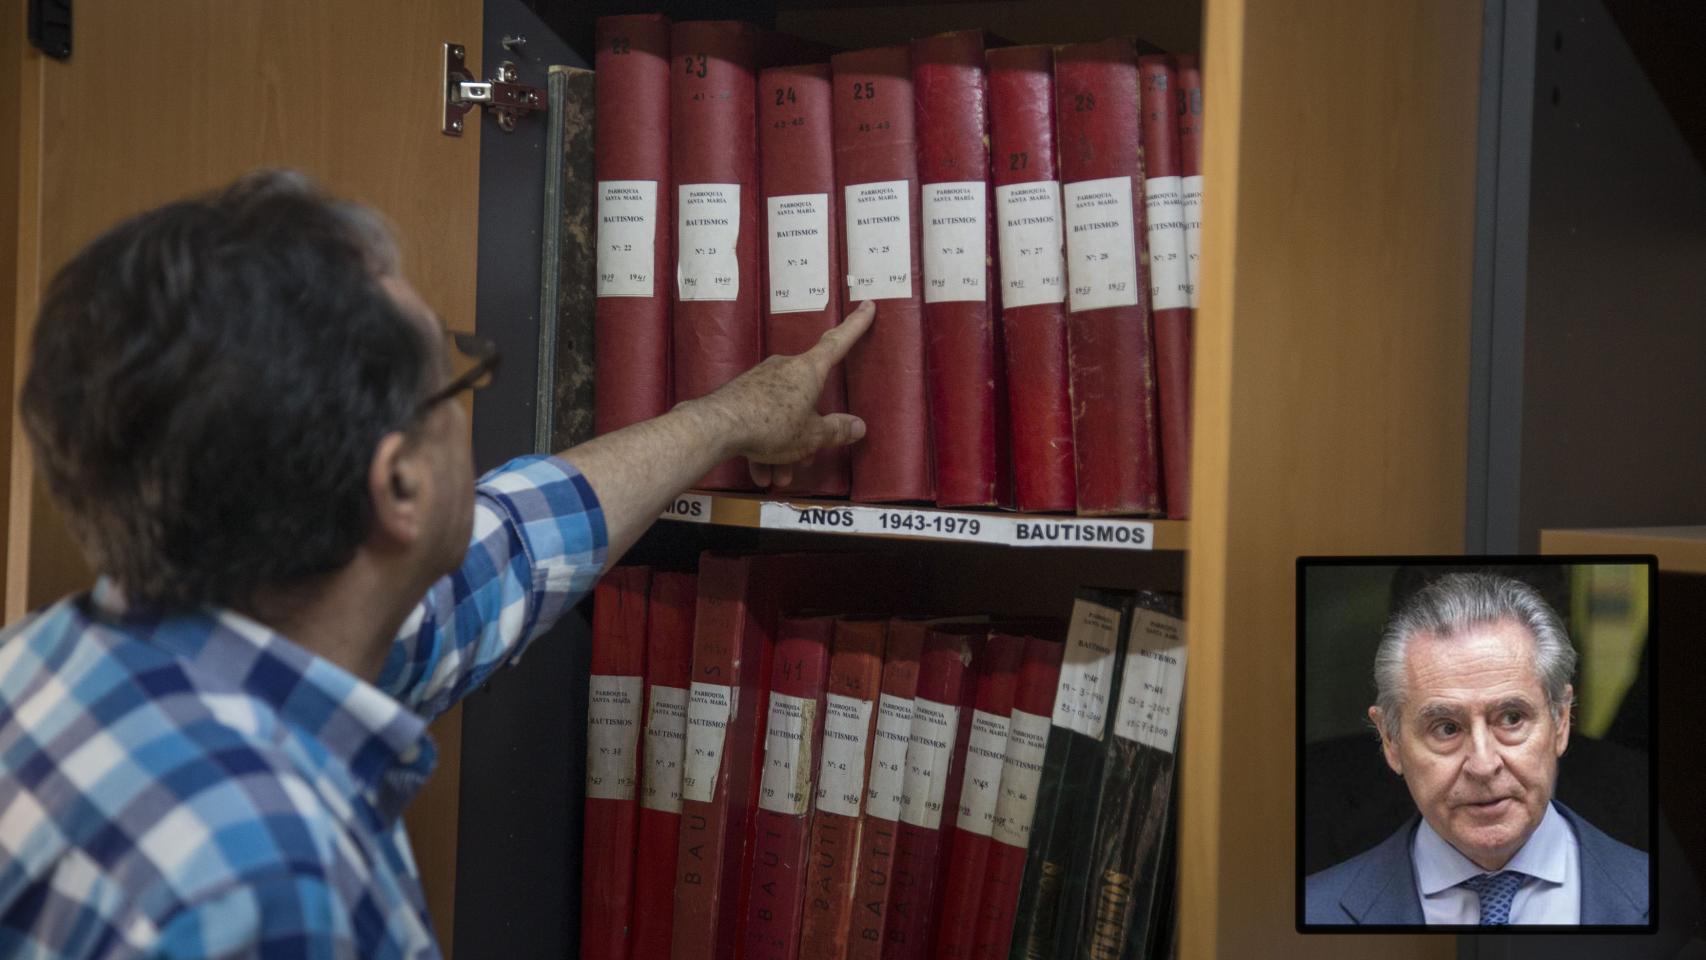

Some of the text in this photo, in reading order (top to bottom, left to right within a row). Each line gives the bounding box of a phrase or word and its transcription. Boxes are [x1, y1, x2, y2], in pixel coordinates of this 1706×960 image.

[685, 54, 707, 78] 23
[775, 87, 796, 106] 24
[853, 82, 874, 101] 25
[1010, 152, 1028, 170] 27
[603, 216, 644, 224] BAUTISMOS
[685, 218, 729, 227] BAUTISMOS
[857, 215, 901, 226] BAUTISMOS
[932, 216, 977, 226] BAUTISMOS
[1007, 216, 1055, 228] BAUTISMOS
[1074, 221, 1120, 233] BAUTISMOS
[776, 228, 819, 239] BAUTISMOS
[882, 245, 891, 254] 25
[956, 247, 965, 255] 26
[1034, 246, 1044, 256] 27
[879, 513, 981, 535] 1943-1979
[1016, 523, 1146, 544] BAUTISMOS
[590, 717, 633, 727] BAUTISMOS
[824, 729, 860, 743] BAUTISMOS
[910, 734, 948, 750] BAUTISMOS
[838, 763, 847, 771] 42
[922, 769, 932, 777] 44
